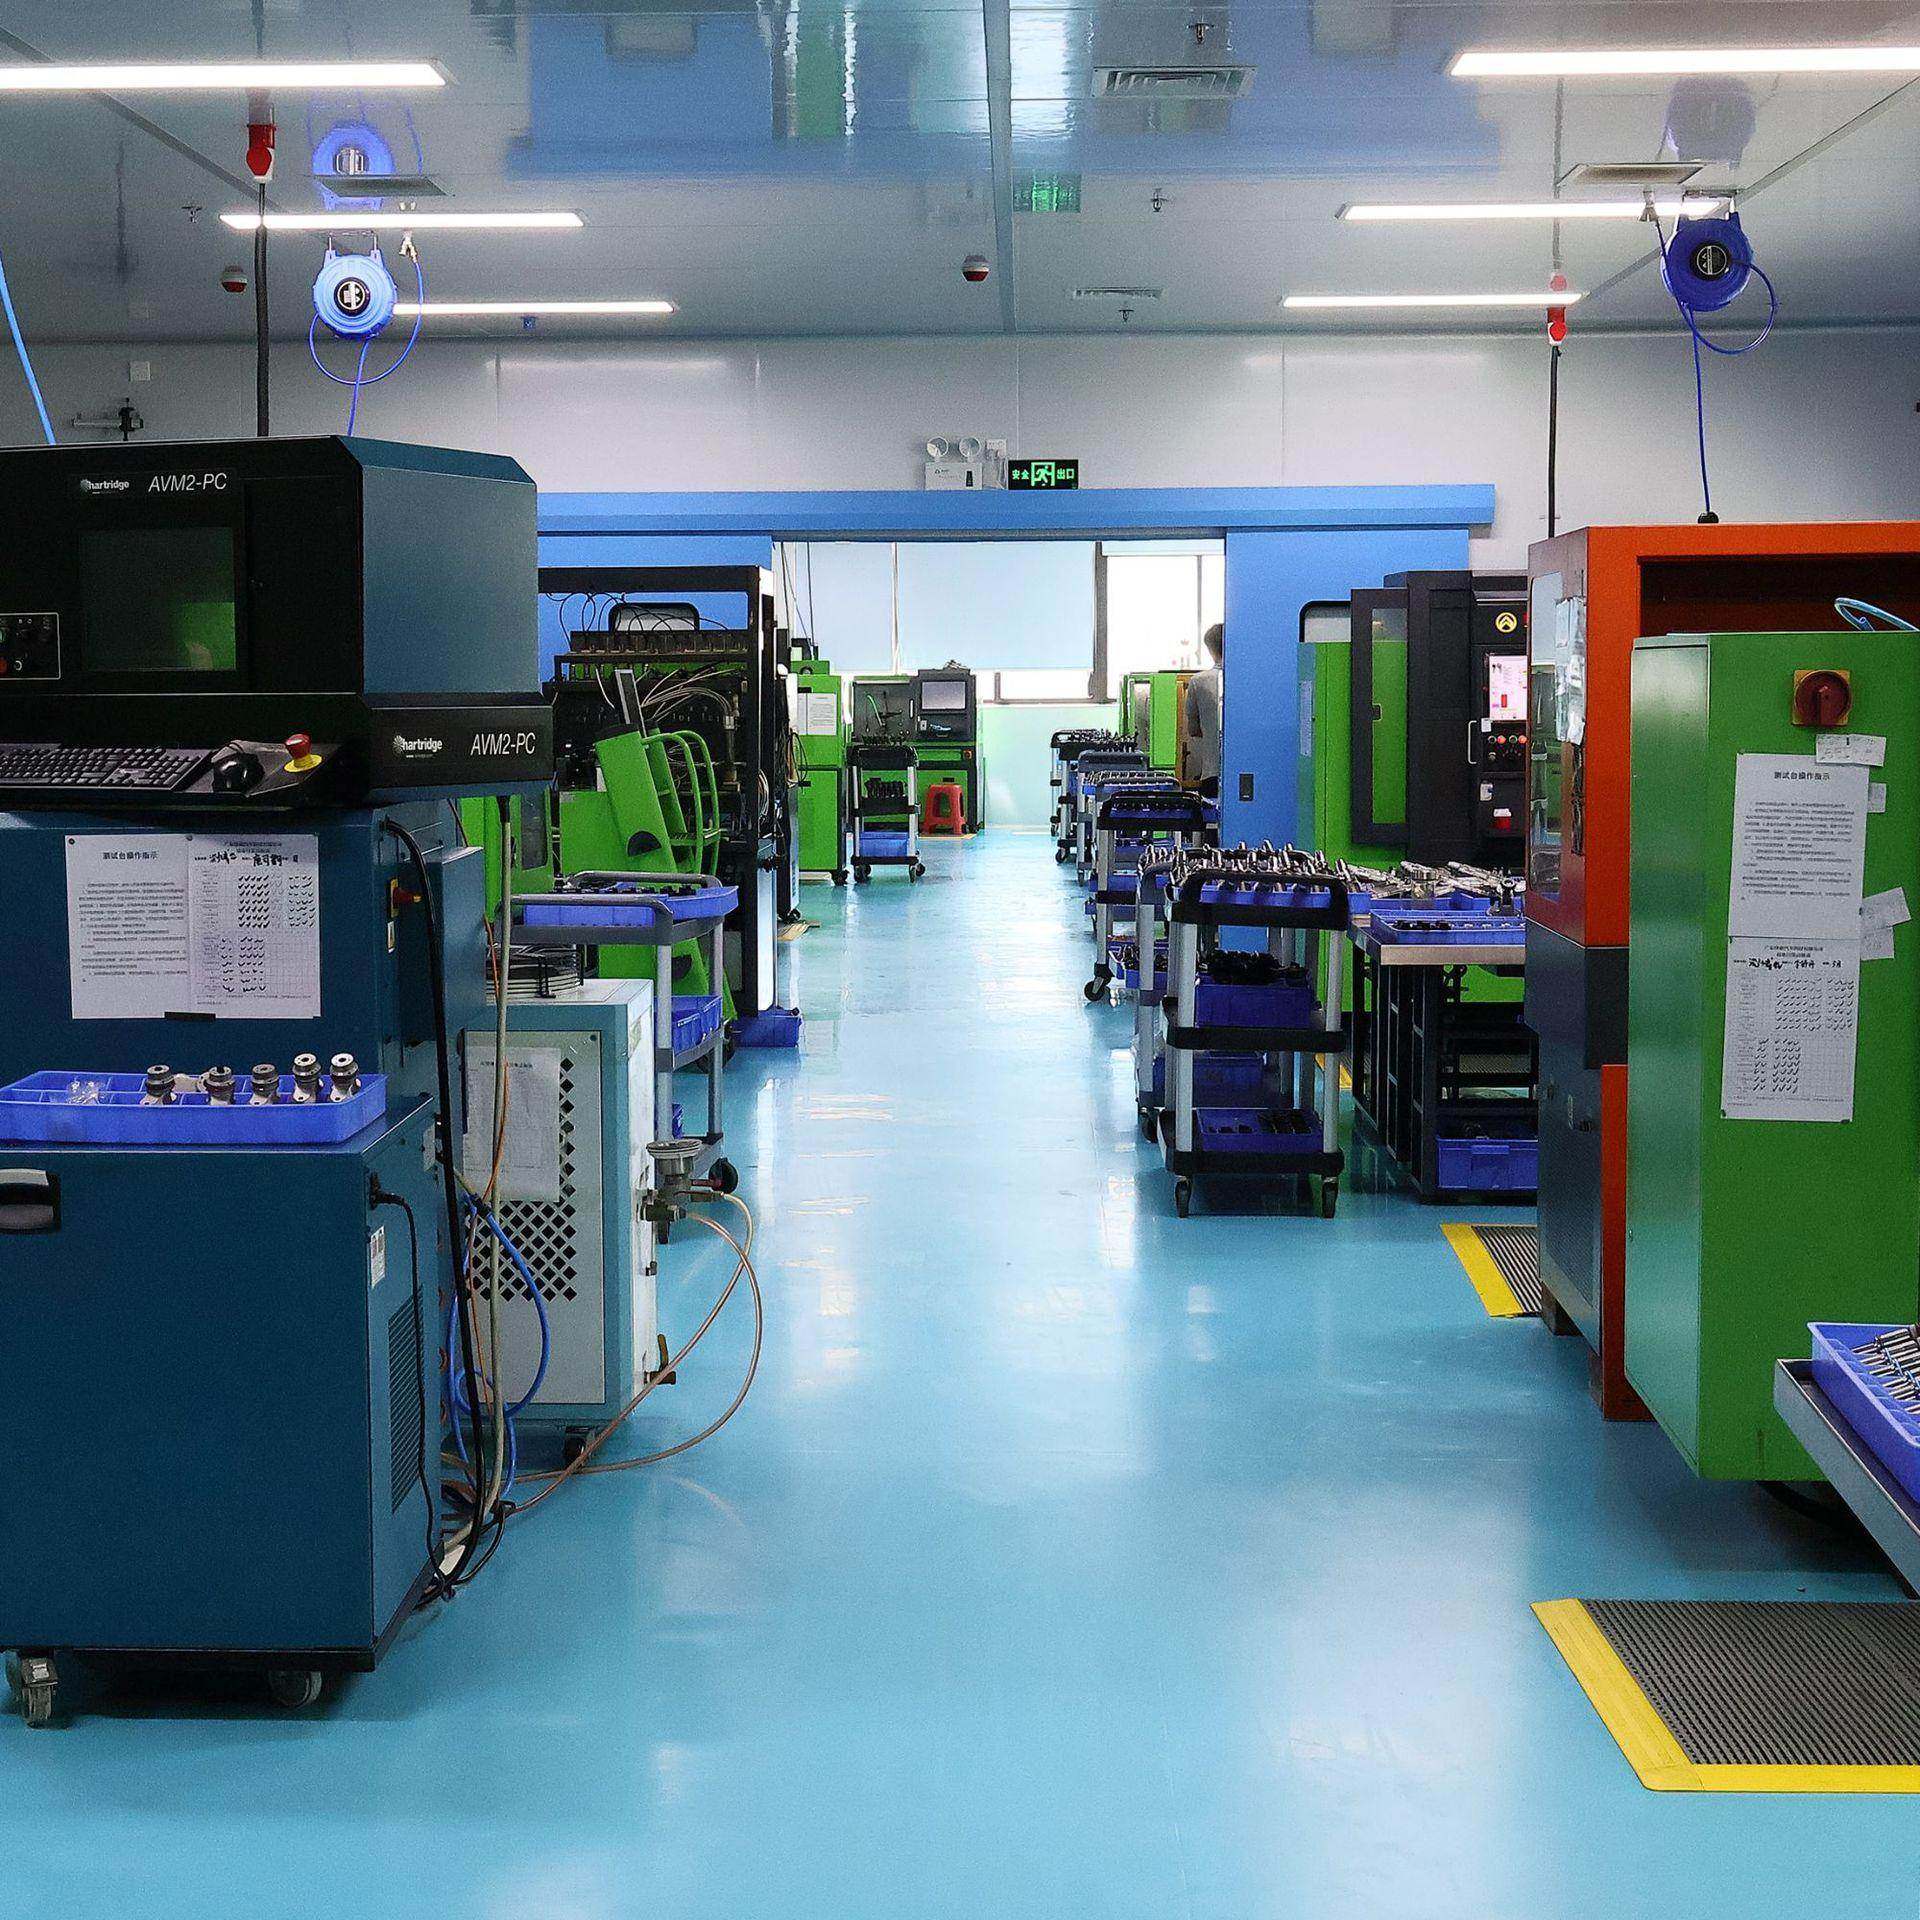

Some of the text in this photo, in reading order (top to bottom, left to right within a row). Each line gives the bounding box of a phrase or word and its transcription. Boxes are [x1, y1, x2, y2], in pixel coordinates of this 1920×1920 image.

[1012, 468, 1075, 480] 安全 出口
[88, 480, 130, 491] hartridge
[148, 473, 227, 493] AVM2-PC
[402, 738, 444, 753] hartridge
[470, 732, 536, 756] AVM2-PC
